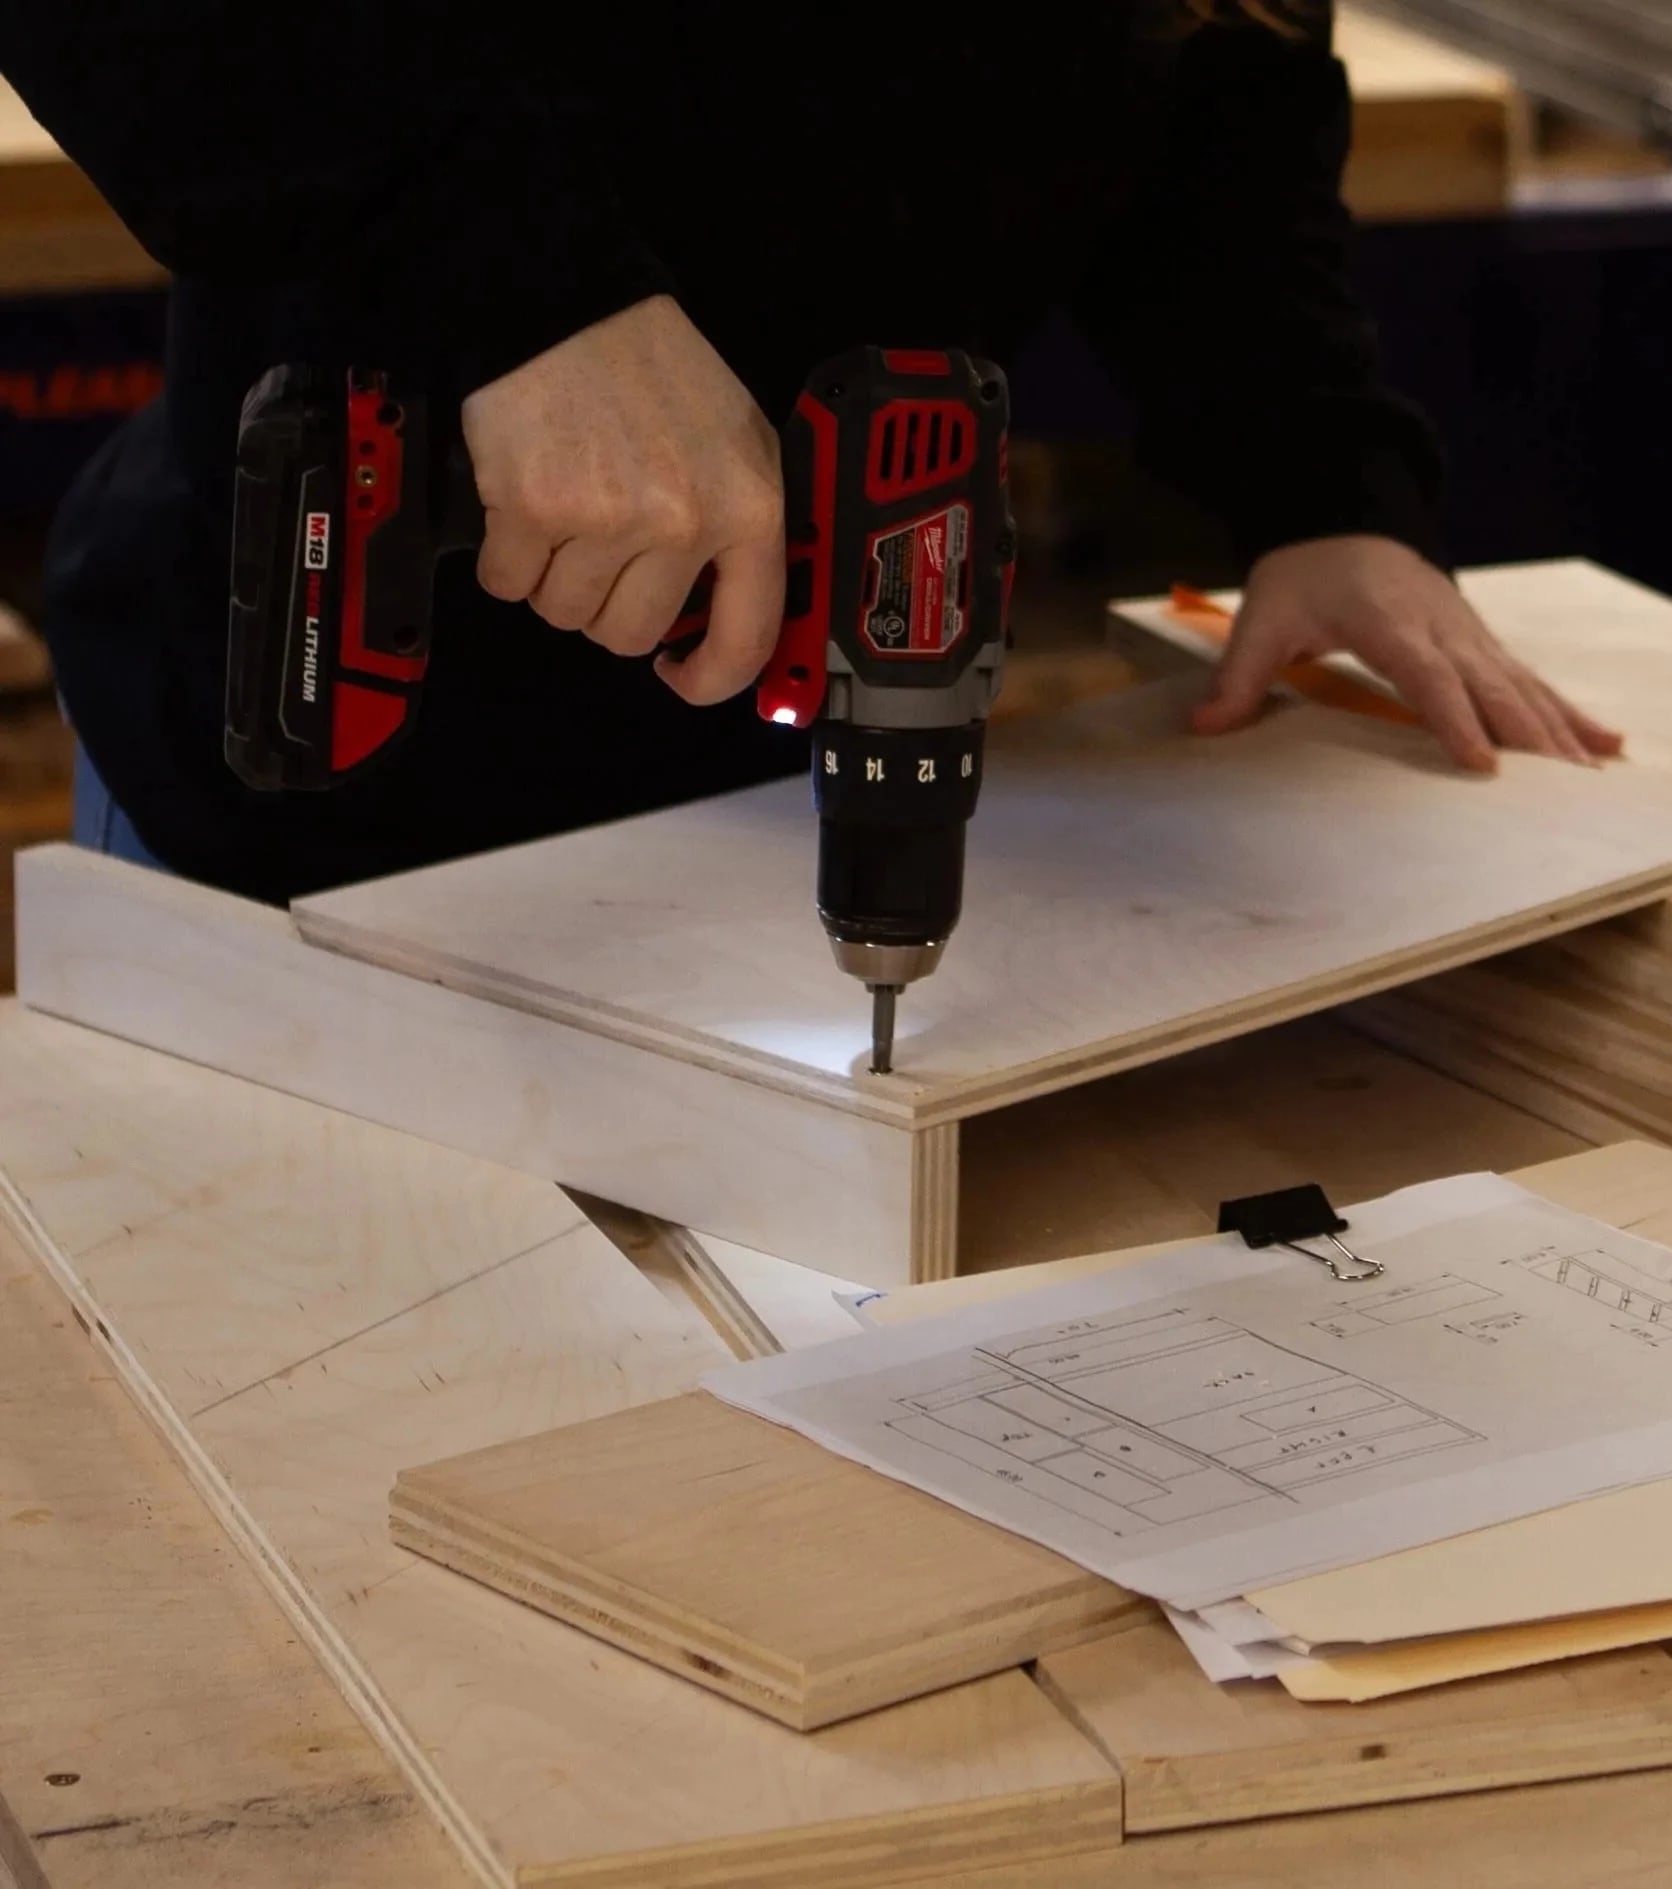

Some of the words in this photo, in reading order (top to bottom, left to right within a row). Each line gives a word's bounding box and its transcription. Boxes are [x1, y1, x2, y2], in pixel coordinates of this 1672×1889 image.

[309, 516, 326, 565] M18
[825, 750, 839, 775] 16
[865, 757, 885, 782] 14
[917, 758, 936, 783] 12
[961, 752, 973, 778] 10
